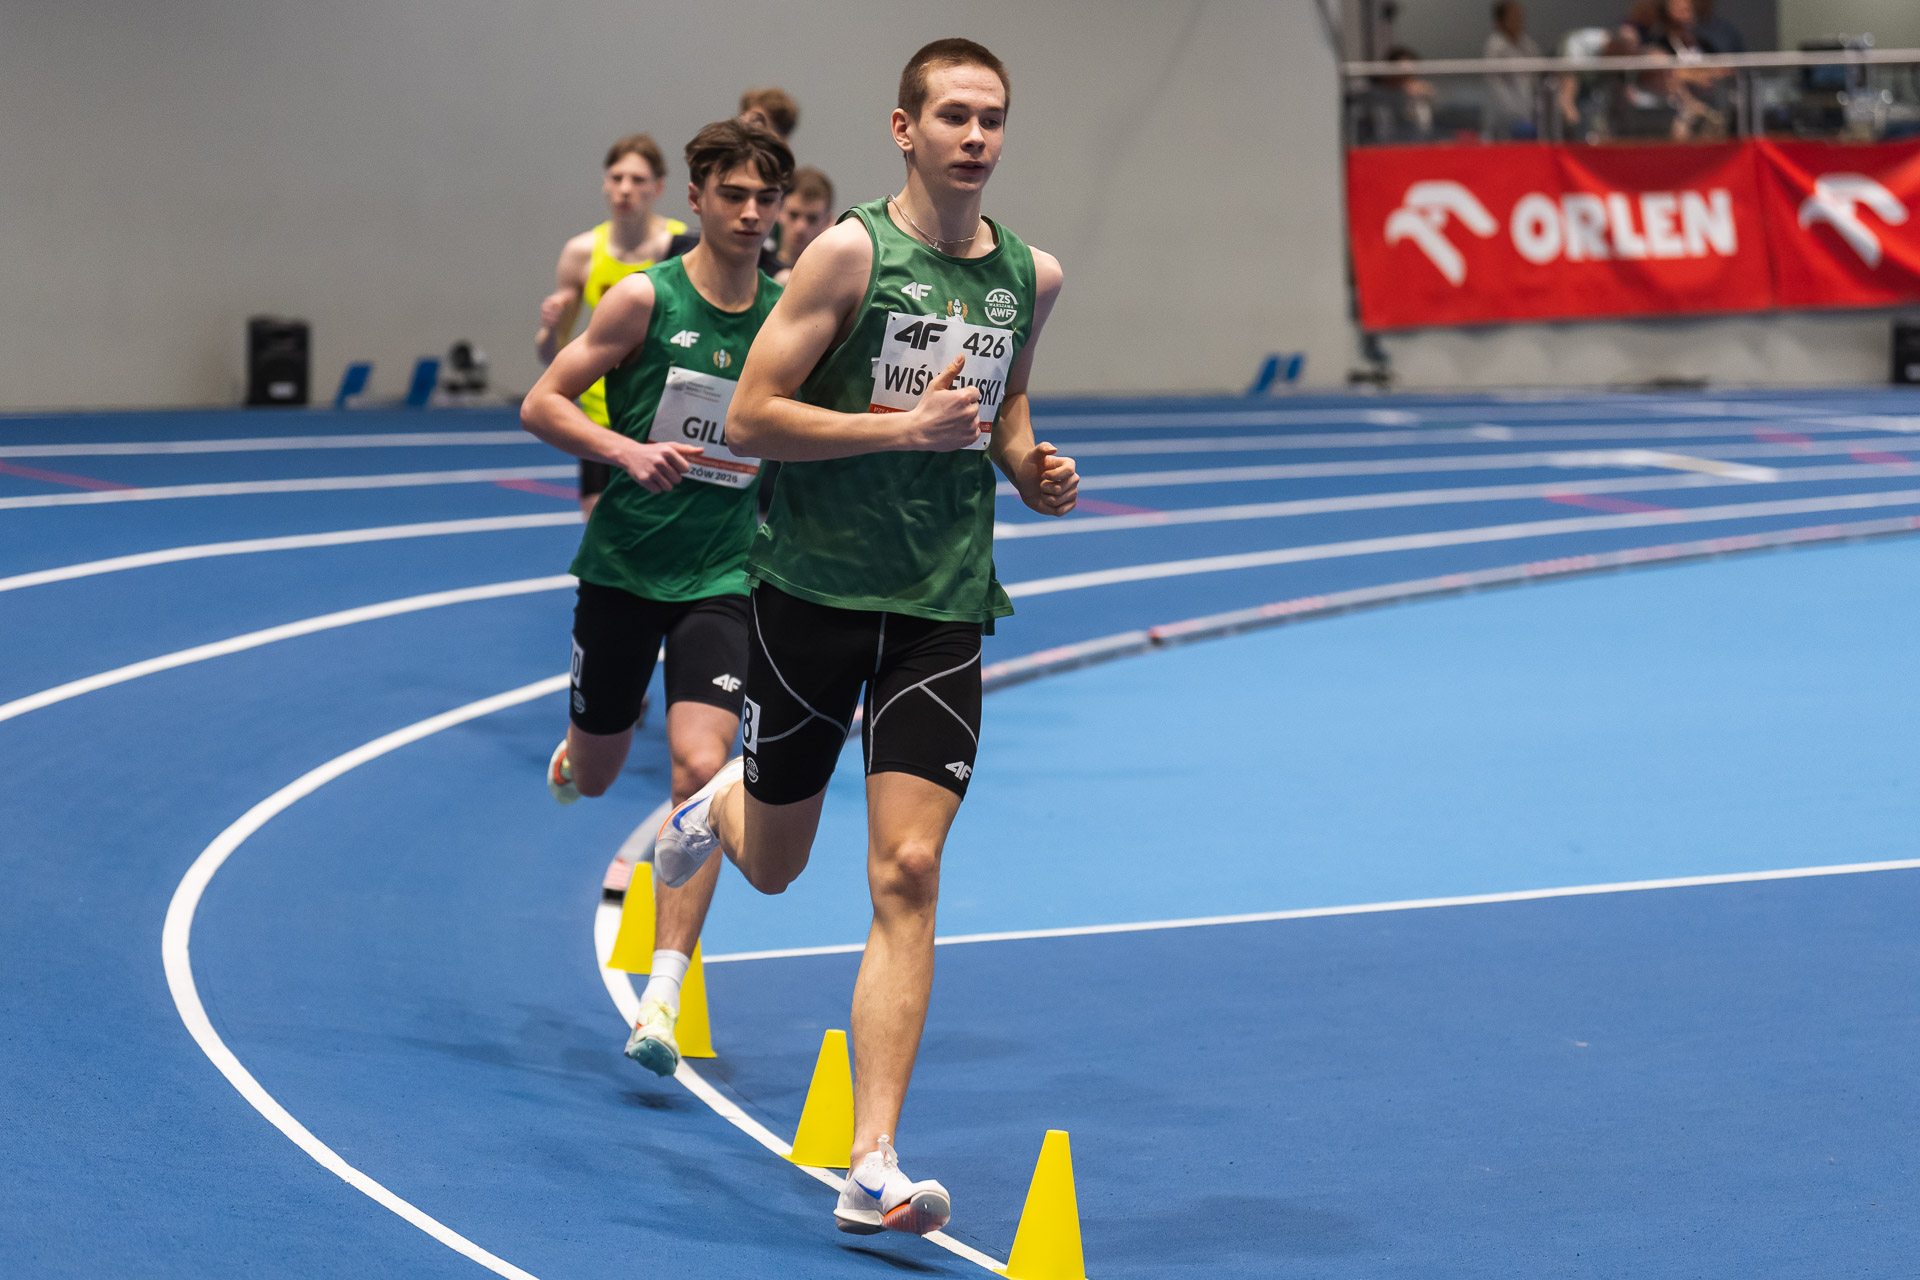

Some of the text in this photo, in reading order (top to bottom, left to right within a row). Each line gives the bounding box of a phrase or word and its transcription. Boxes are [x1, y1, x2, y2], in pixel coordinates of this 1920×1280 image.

[1511, 188, 1737, 264] ORLEN
[901, 281, 932, 301] 4F
[992, 293, 1011, 304] AZS
[990, 307, 1013, 318] AWF
[670, 330, 700, 348] 4F
[894, 320, 1006, 359] 4F 426
[885, 363, 1001, 406] WIŚEWSKI
[689, 466, 738, 483] ZÓW 2026
[712, 673, 742, 693] 4F
[743, 701, 753, 744] 8
[945, 761, 973, 781] 4F
